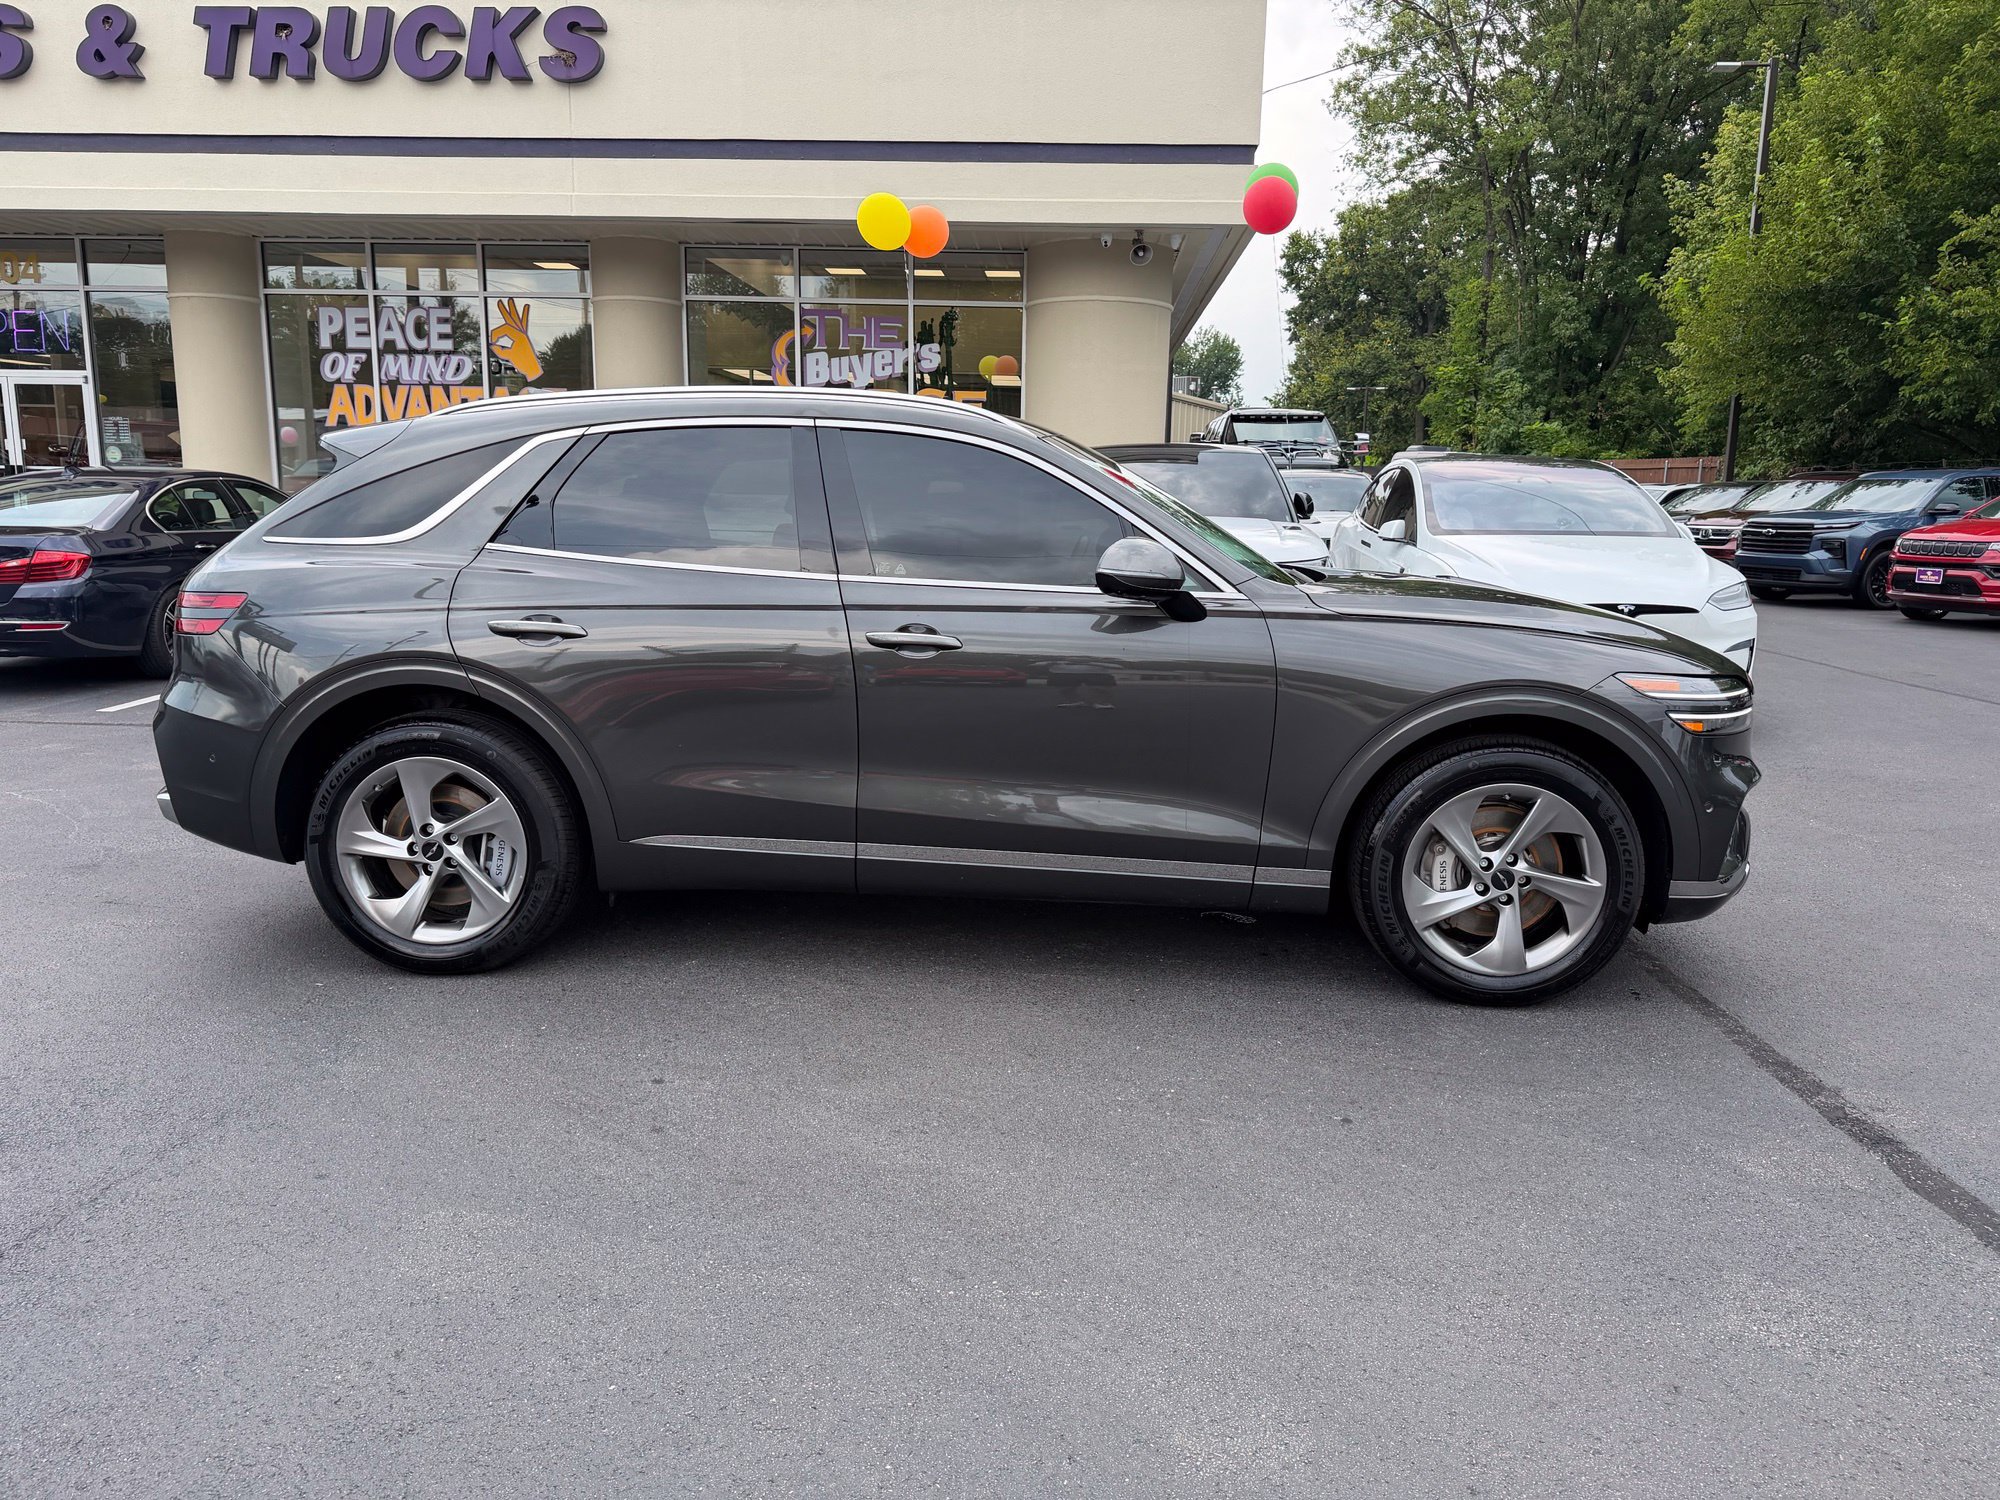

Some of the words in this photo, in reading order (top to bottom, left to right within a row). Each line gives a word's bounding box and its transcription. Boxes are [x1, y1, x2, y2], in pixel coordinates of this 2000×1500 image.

[76, 4, 146, 80] &
[194, 5, 608, 83] TRUCKS
[318, 306, 455, 351] PEACE
[801, 308, 904, 351] THE
[320, 352, 367, 383] OF
[380, 353, 474, 386] MIND
[318, 748, 373, 811] MICHELIN
[494, 839, 506, 877] GENESIS
[1439, 860, 1447, 891] ENESIS
[1613, 826, 1635, 909] MICHELIN
[1377, 854, 1399, 936] MICHELIN
